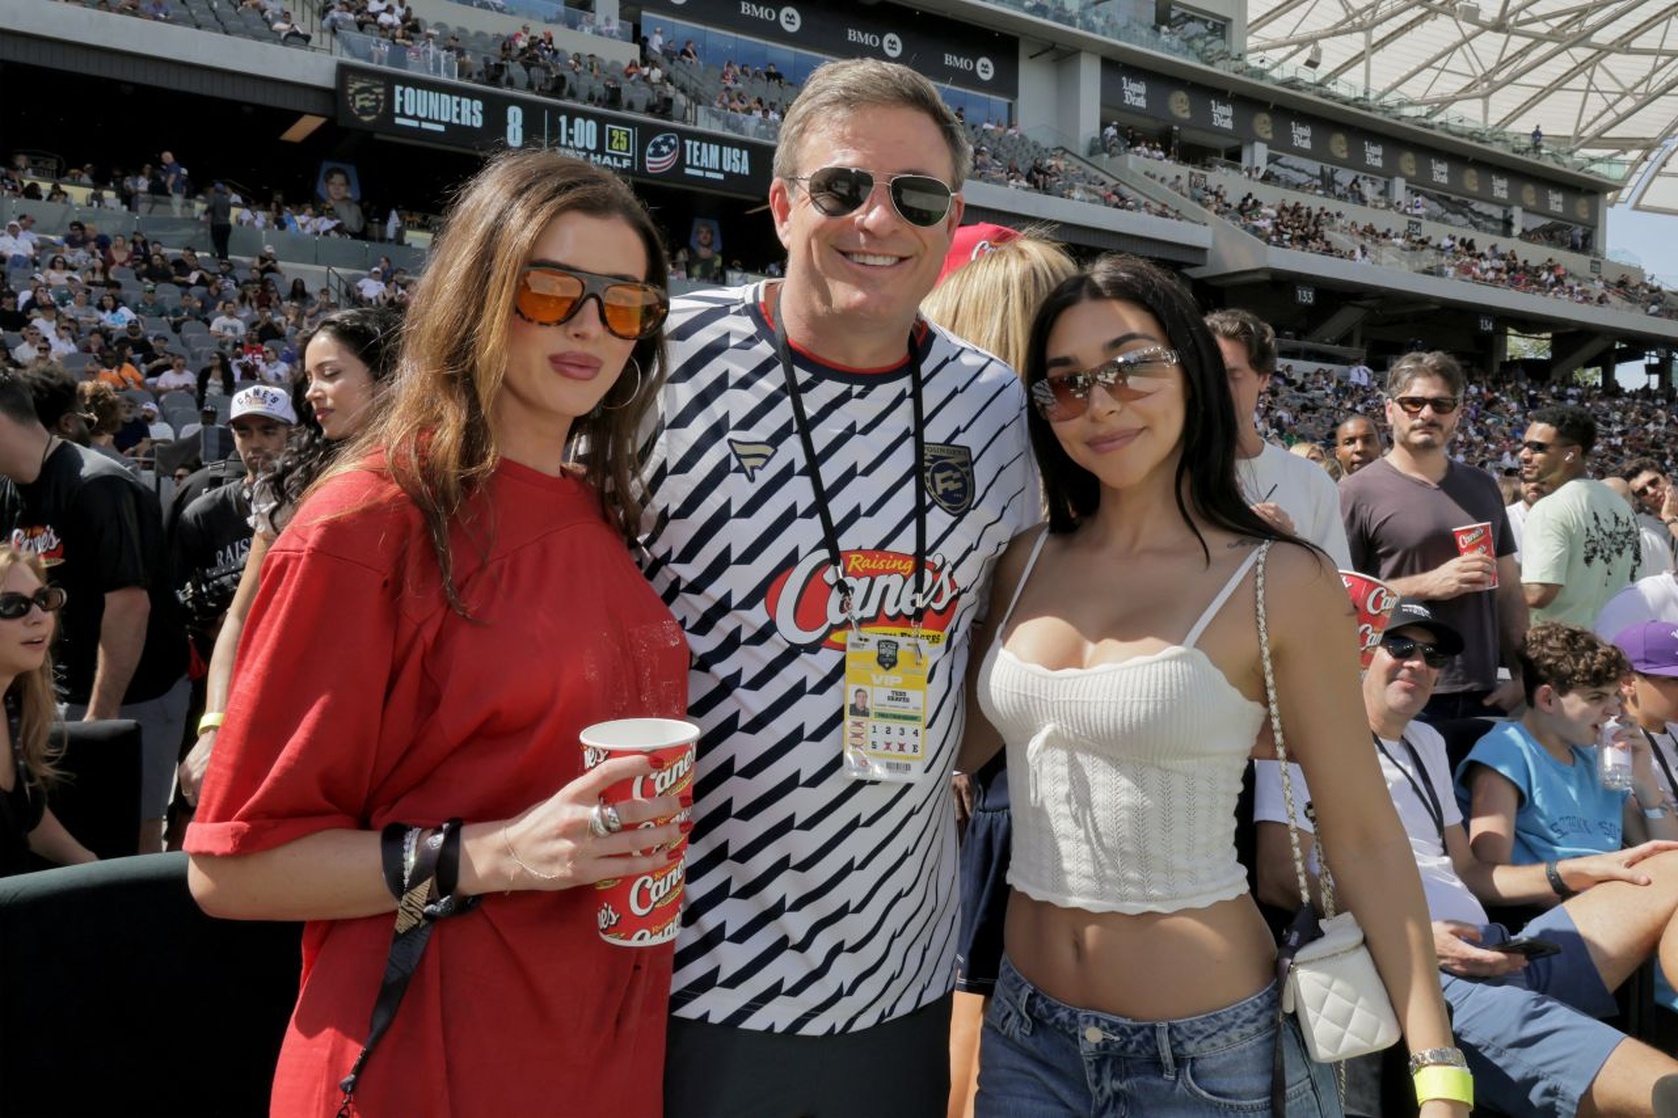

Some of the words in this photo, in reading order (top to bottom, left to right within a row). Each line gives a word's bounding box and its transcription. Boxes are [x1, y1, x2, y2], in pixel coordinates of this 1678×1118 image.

[739, 1, 776, 21] BMO
[847, 27, 880, 48] BMO
[943, 53, 974, 72] BMO
[1121, 75, 1146, 95] Liquid
[394, 84, 483, 128] FOUNDERS
[1124, 91, 1147, 109] Death
[1210, 99, 1233, 118] Liquid
[507, 105, 523, 148] 8
[558, 114, 598, 150] 1:00
[1212, 114, 1233, 130] Death
[611, 129, 628, 151] 25
[589, 152, 632, 169] HALF
[684, 139, 719, 170] TEAM
[722, 146, 750, 176] USA
[237, 388, 279, 405] CANE'S
[847, 553, 914, 575] Raising
[775, 549, 960, 645] Cane's
[912, 729, 919, 737] 4
